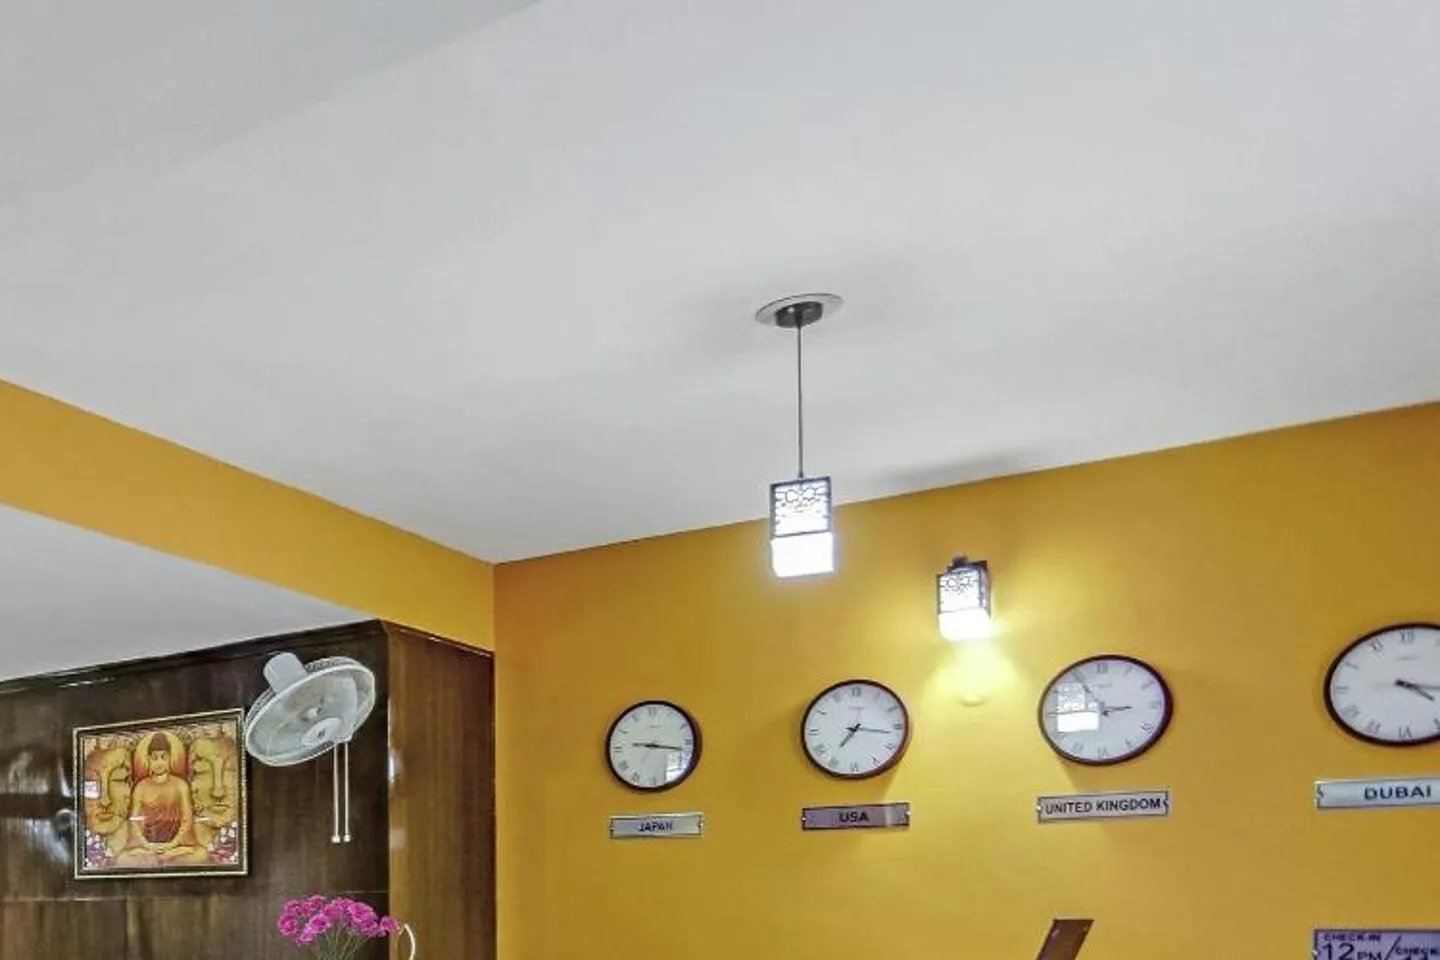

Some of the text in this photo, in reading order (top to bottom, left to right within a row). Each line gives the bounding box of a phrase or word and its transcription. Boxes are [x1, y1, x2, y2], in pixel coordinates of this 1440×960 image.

[1363, 785, 1432, 801] DUBAI
[1045, 797, 1161, 815] UNITED KINGDOM
[838, 811, 870, 823] USA
[638, 820, 673, 832] JAPAN
